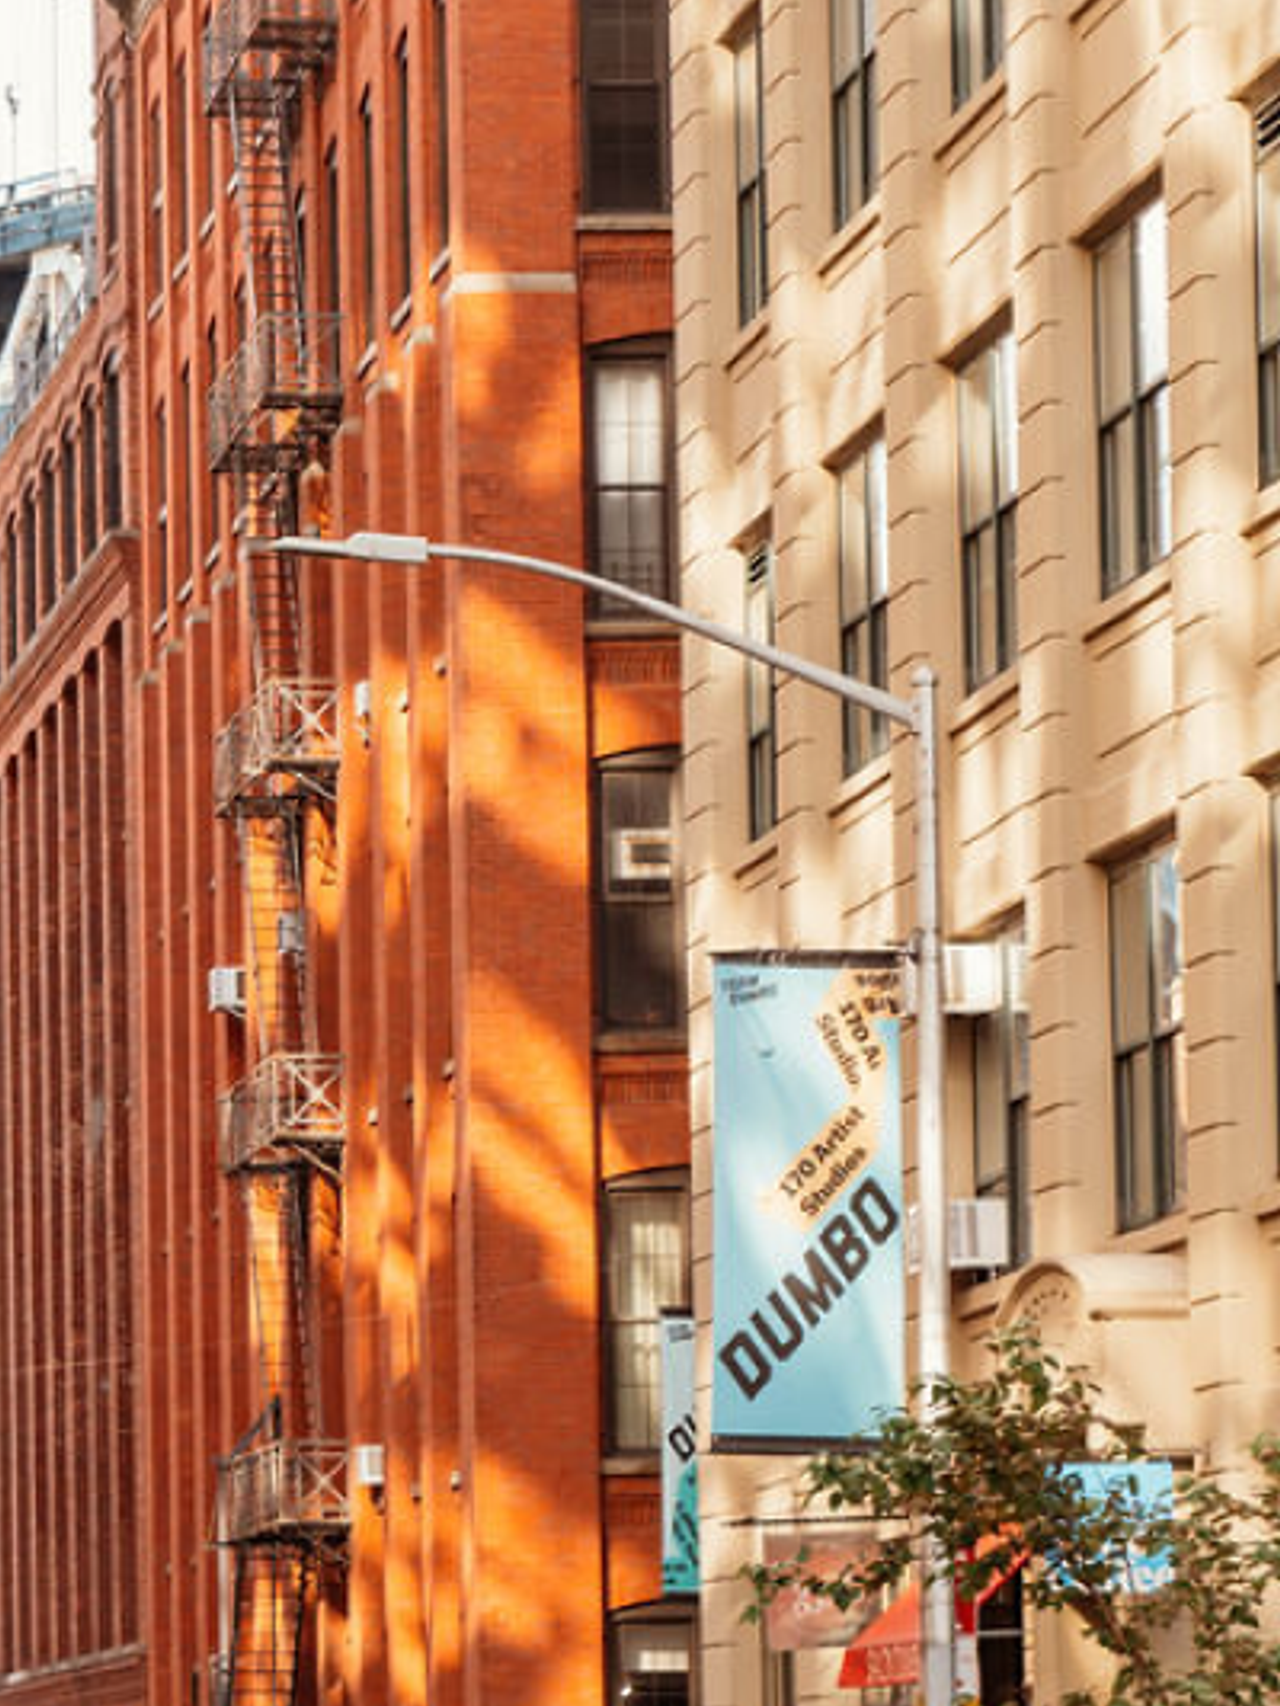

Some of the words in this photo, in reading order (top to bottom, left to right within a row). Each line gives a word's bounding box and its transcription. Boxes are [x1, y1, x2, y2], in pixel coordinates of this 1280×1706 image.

[779, 1158, 818, 1198] 170
[812, 1105, 866, 1164] Artist
[800, 1146, 868, 1216] Studios
[716, 1176, 900, 1402] DUMBO
